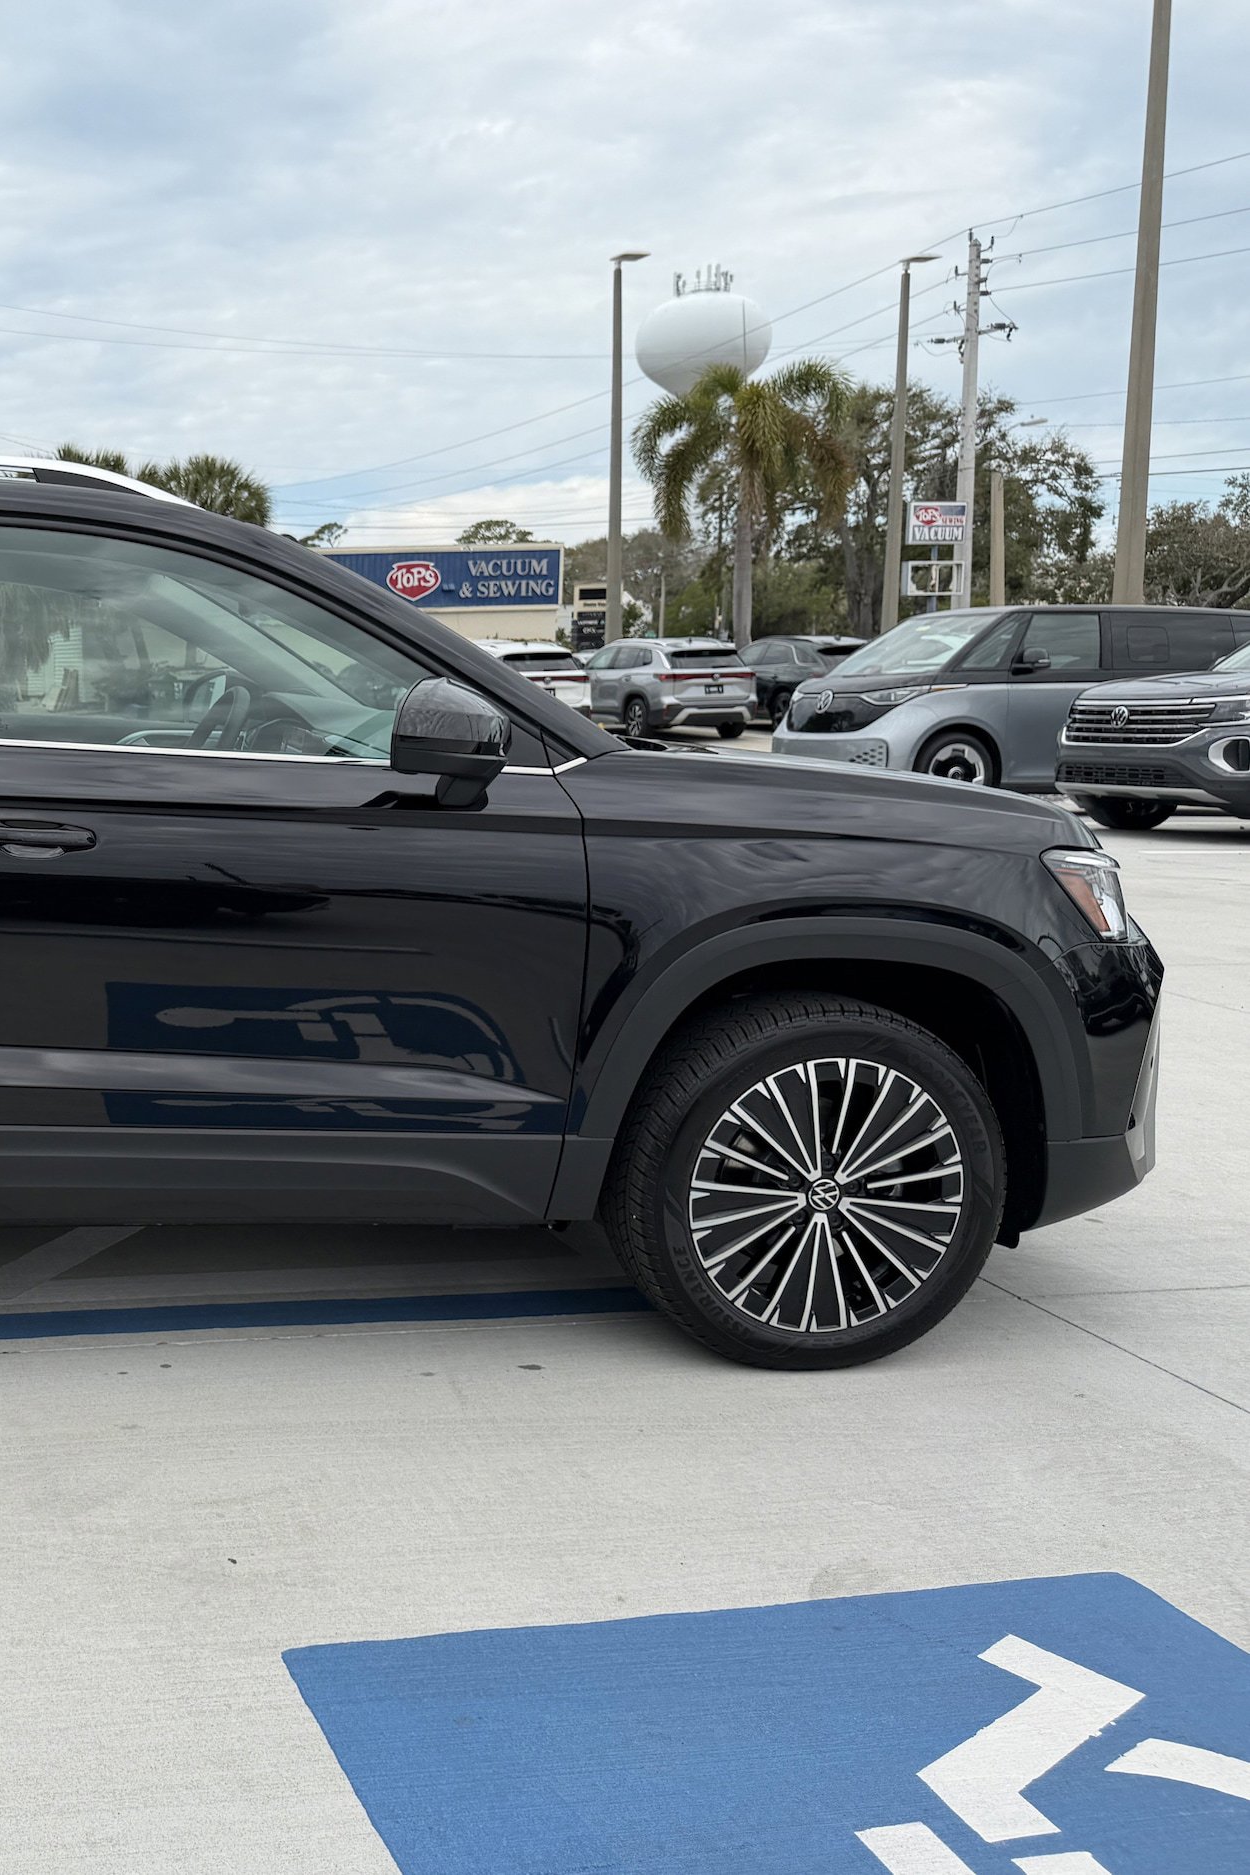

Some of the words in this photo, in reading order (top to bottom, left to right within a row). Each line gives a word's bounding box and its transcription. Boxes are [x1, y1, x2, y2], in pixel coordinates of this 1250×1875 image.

[913, 526, 963, 541] VACUUM
[467, 558, 549, 577] VACUUM
[458, 582, 473, 599] &
[476, 579, 556, 598] SEWING
